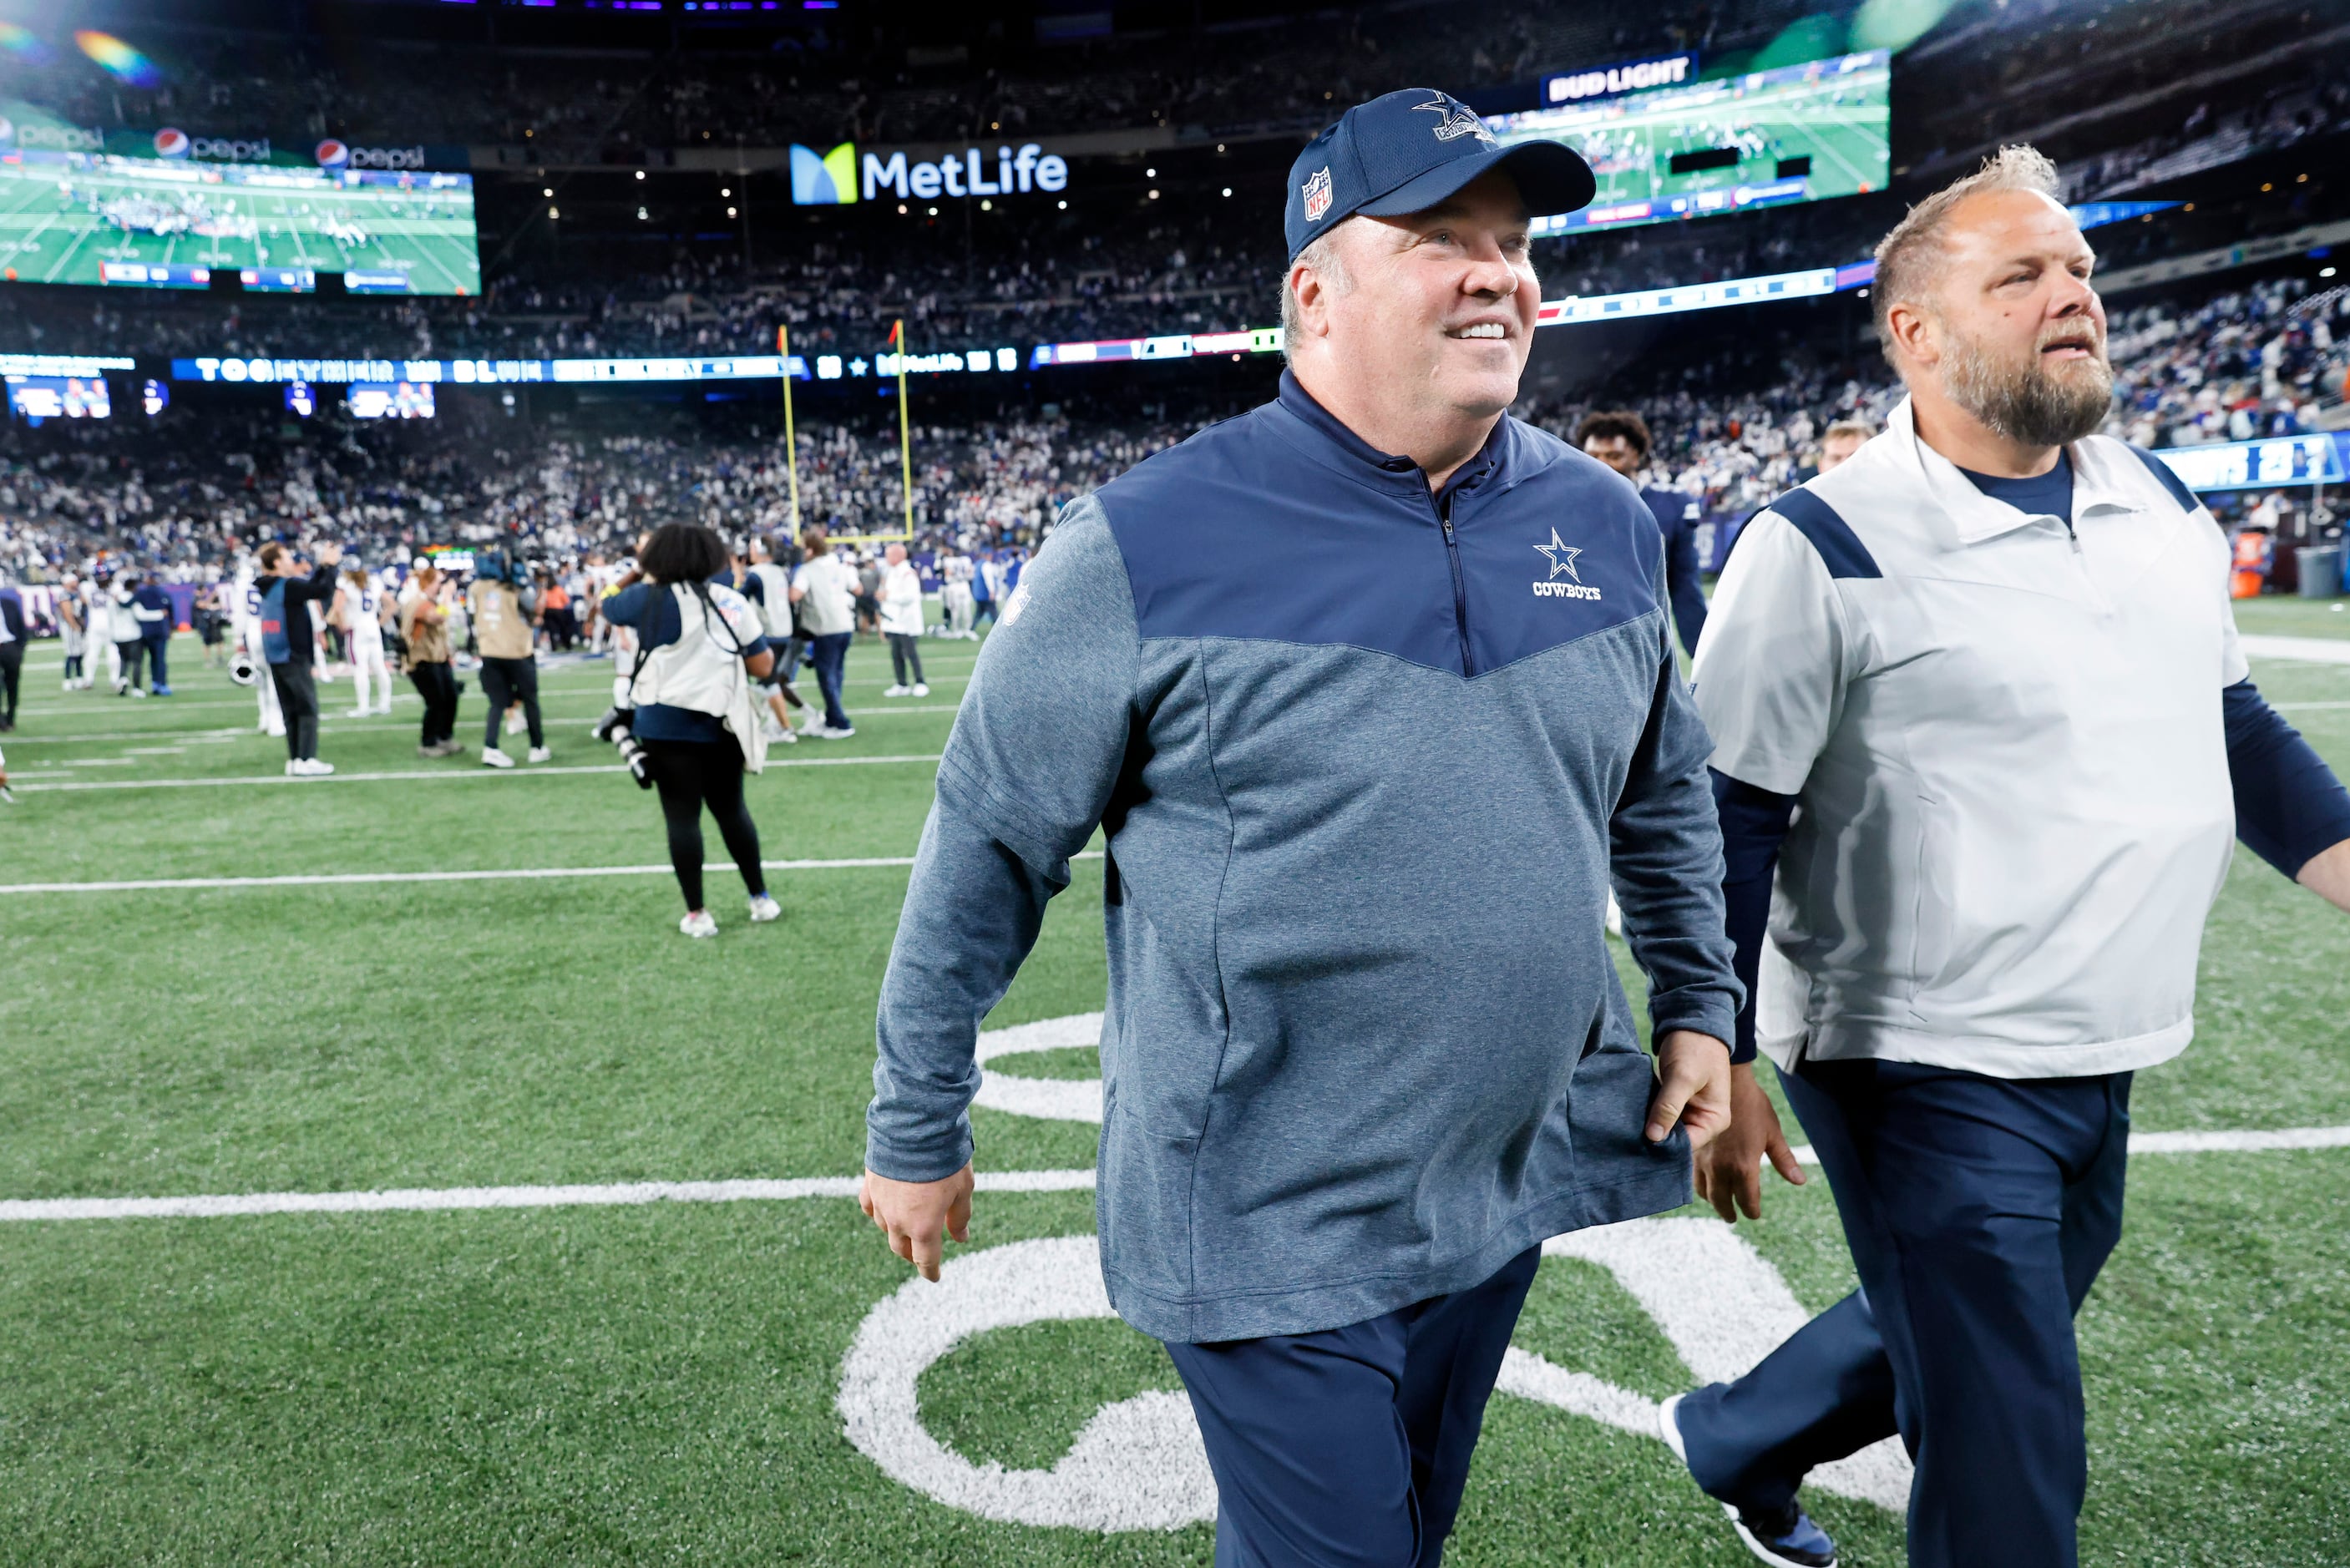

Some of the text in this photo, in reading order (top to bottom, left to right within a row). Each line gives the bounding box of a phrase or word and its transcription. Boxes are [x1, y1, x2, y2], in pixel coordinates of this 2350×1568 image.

[1549, 58, 1689, 102] BUD LIGHT
[17, 125, 105, 151] pepsi
[191, 136, 271, 162] pepsi
[350, 144, 424, 170] pepsi
[862, 143, 1069, 200] MetLife
[1309, 188, 1329, 215] NFL
[1532, 581, 1602, 600] COWBOYS
